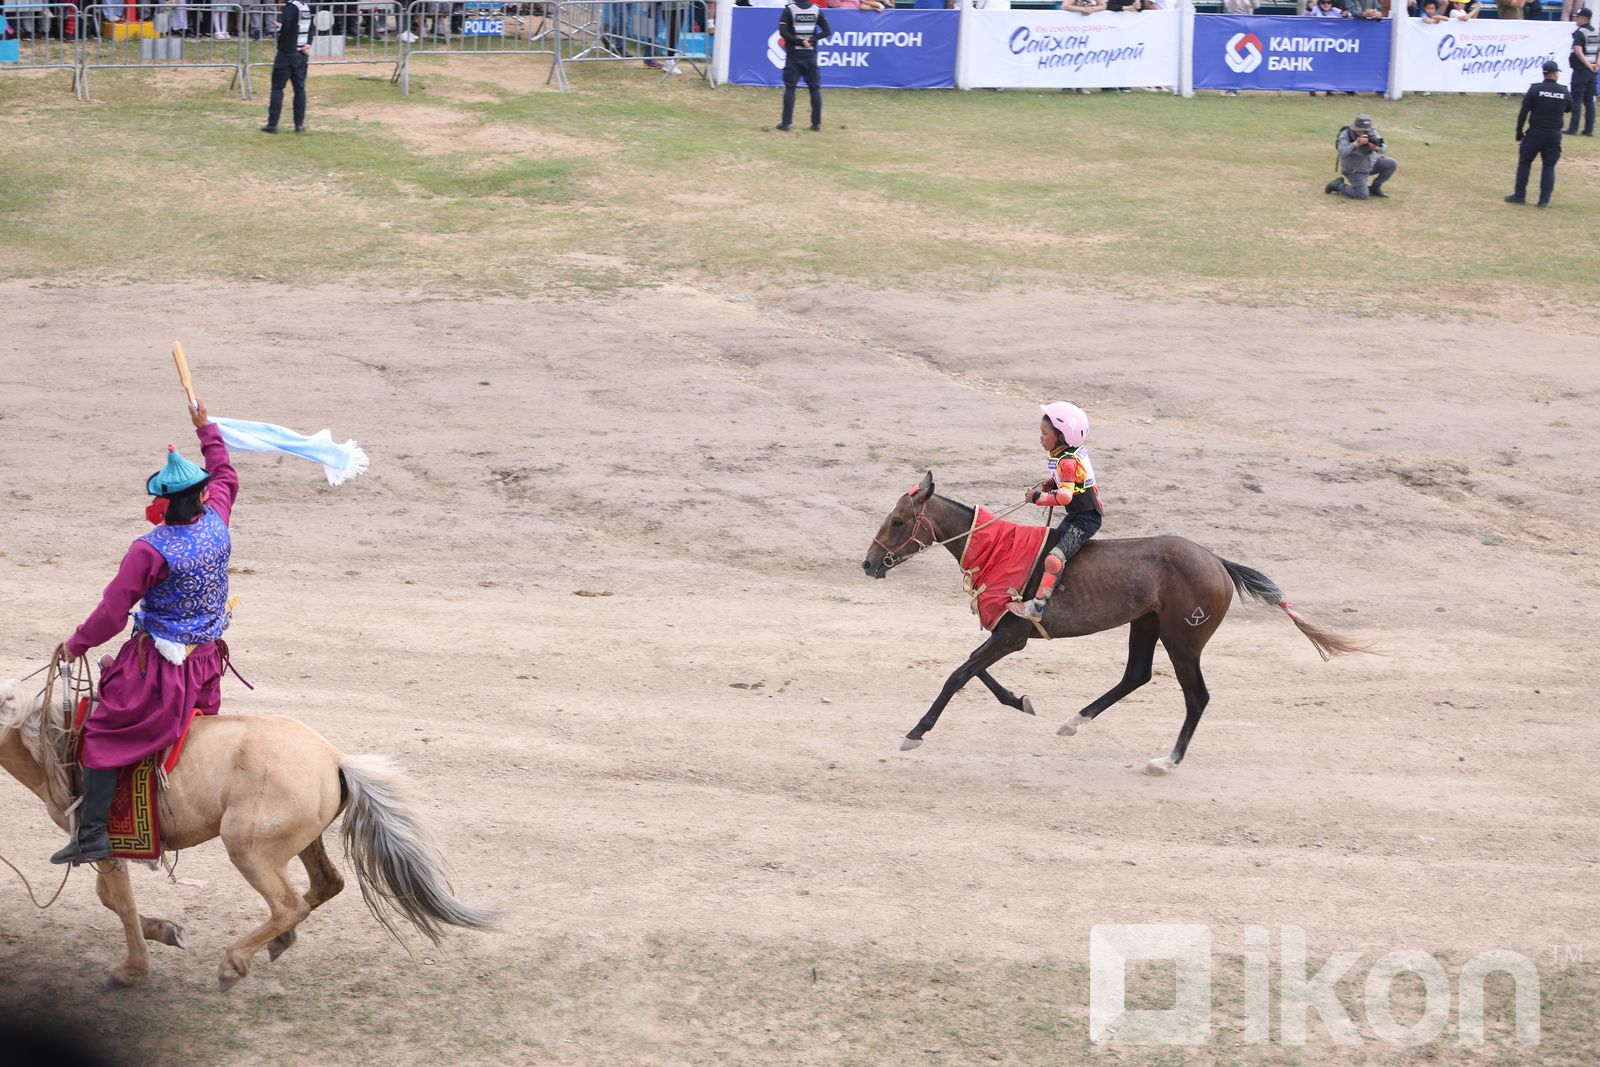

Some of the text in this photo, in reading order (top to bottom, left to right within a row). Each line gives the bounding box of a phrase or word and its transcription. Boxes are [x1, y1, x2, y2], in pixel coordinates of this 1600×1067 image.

[464, 21, 503, 33] POLICE
[1009, 26, 1090, 55] Сайхан
[1269, 37, 1360, 53] КАПИТРОН
[1437, 34, 1507, 61] Сайхан
[817, 52, 870, 67] БАНК
[1038, 42, 1144, 72] наадаарай
[1267, 56, 1314, 72] БАНК
[1539, 91, 1565, 99] POLICE
